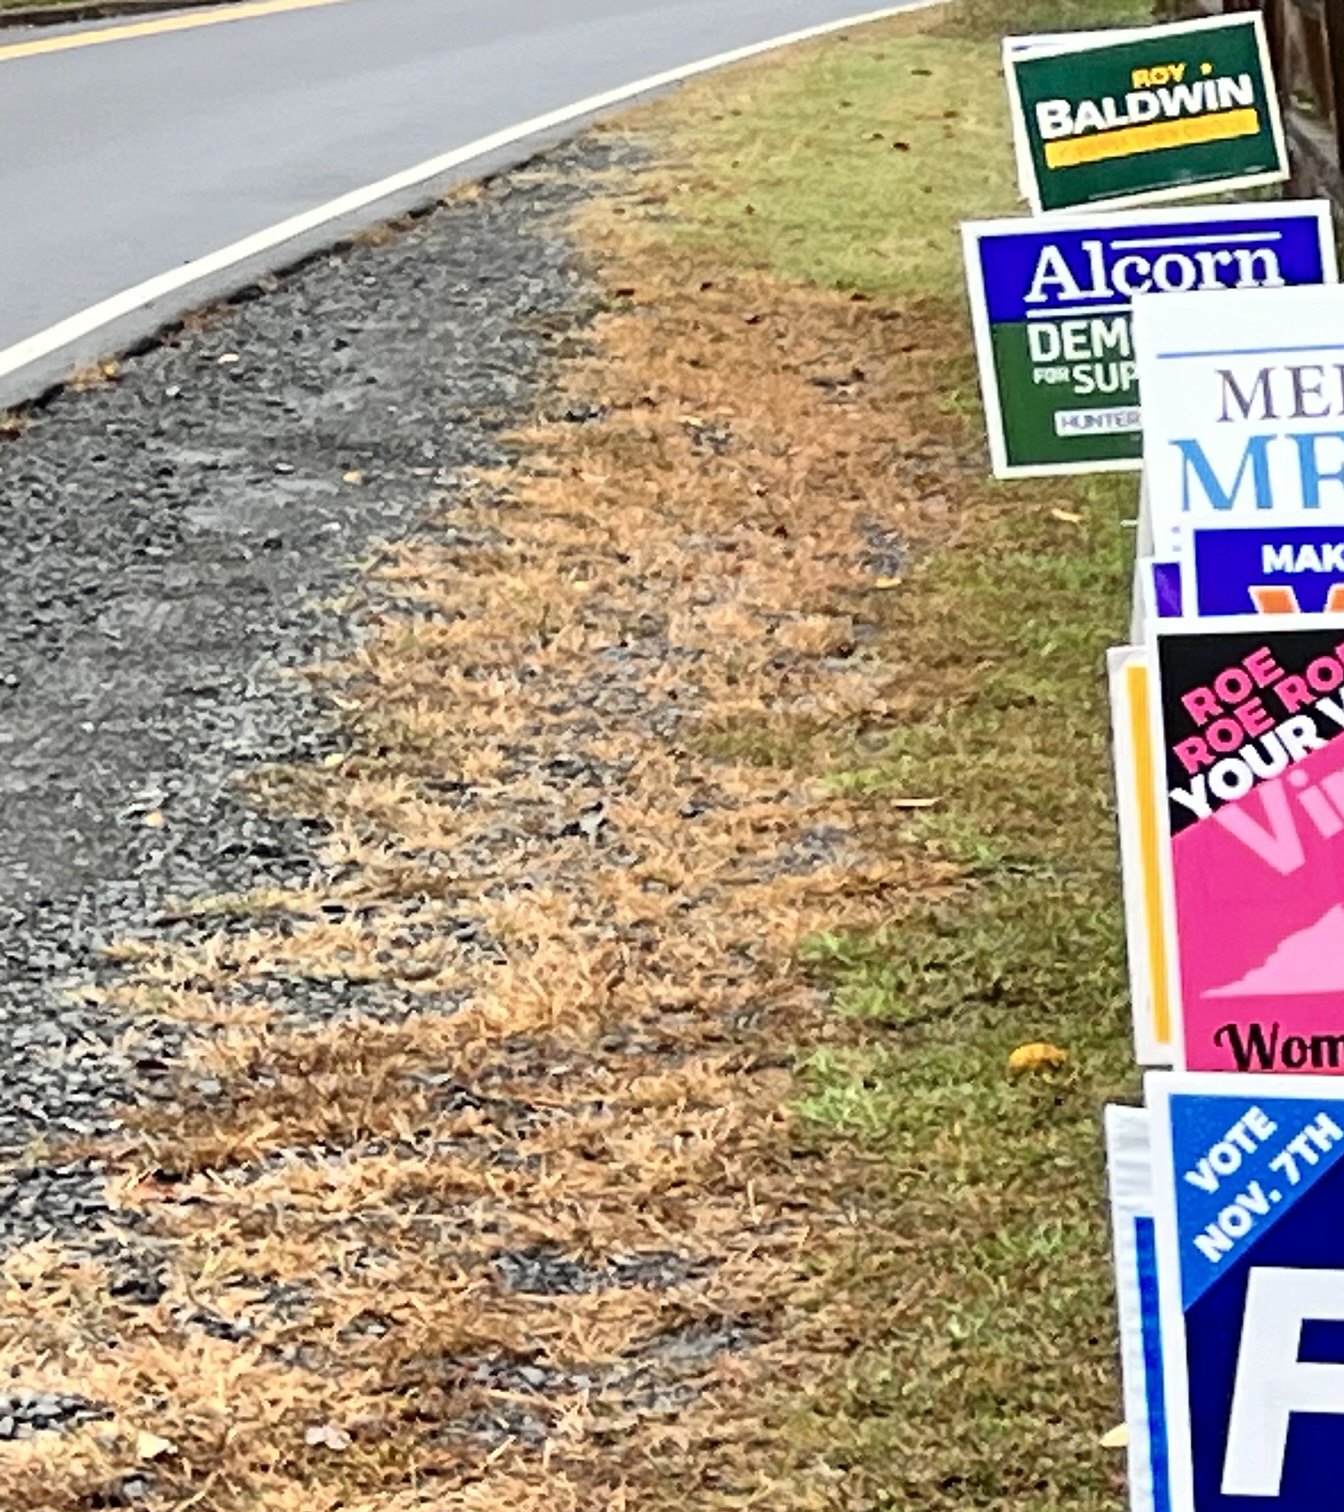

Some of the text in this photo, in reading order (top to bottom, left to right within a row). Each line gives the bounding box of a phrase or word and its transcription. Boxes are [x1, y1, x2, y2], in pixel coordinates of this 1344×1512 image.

[1035, 73, 1254, 140] BALDWIN
[1131, 62, 1185, 90] ROY
[1023, 240, 1286, 302] Alcorn
[1033, 366, 1070, 385] FOR
[1180, 646, 1285, 726] ROE
[1168, 713, 1331, 820] YOUR
[1173, 698, 1275, 775] ROE
[1184, 1104, 1279, 1196] VOTE
[1192, 1179, 1283, 1264] NOV.
